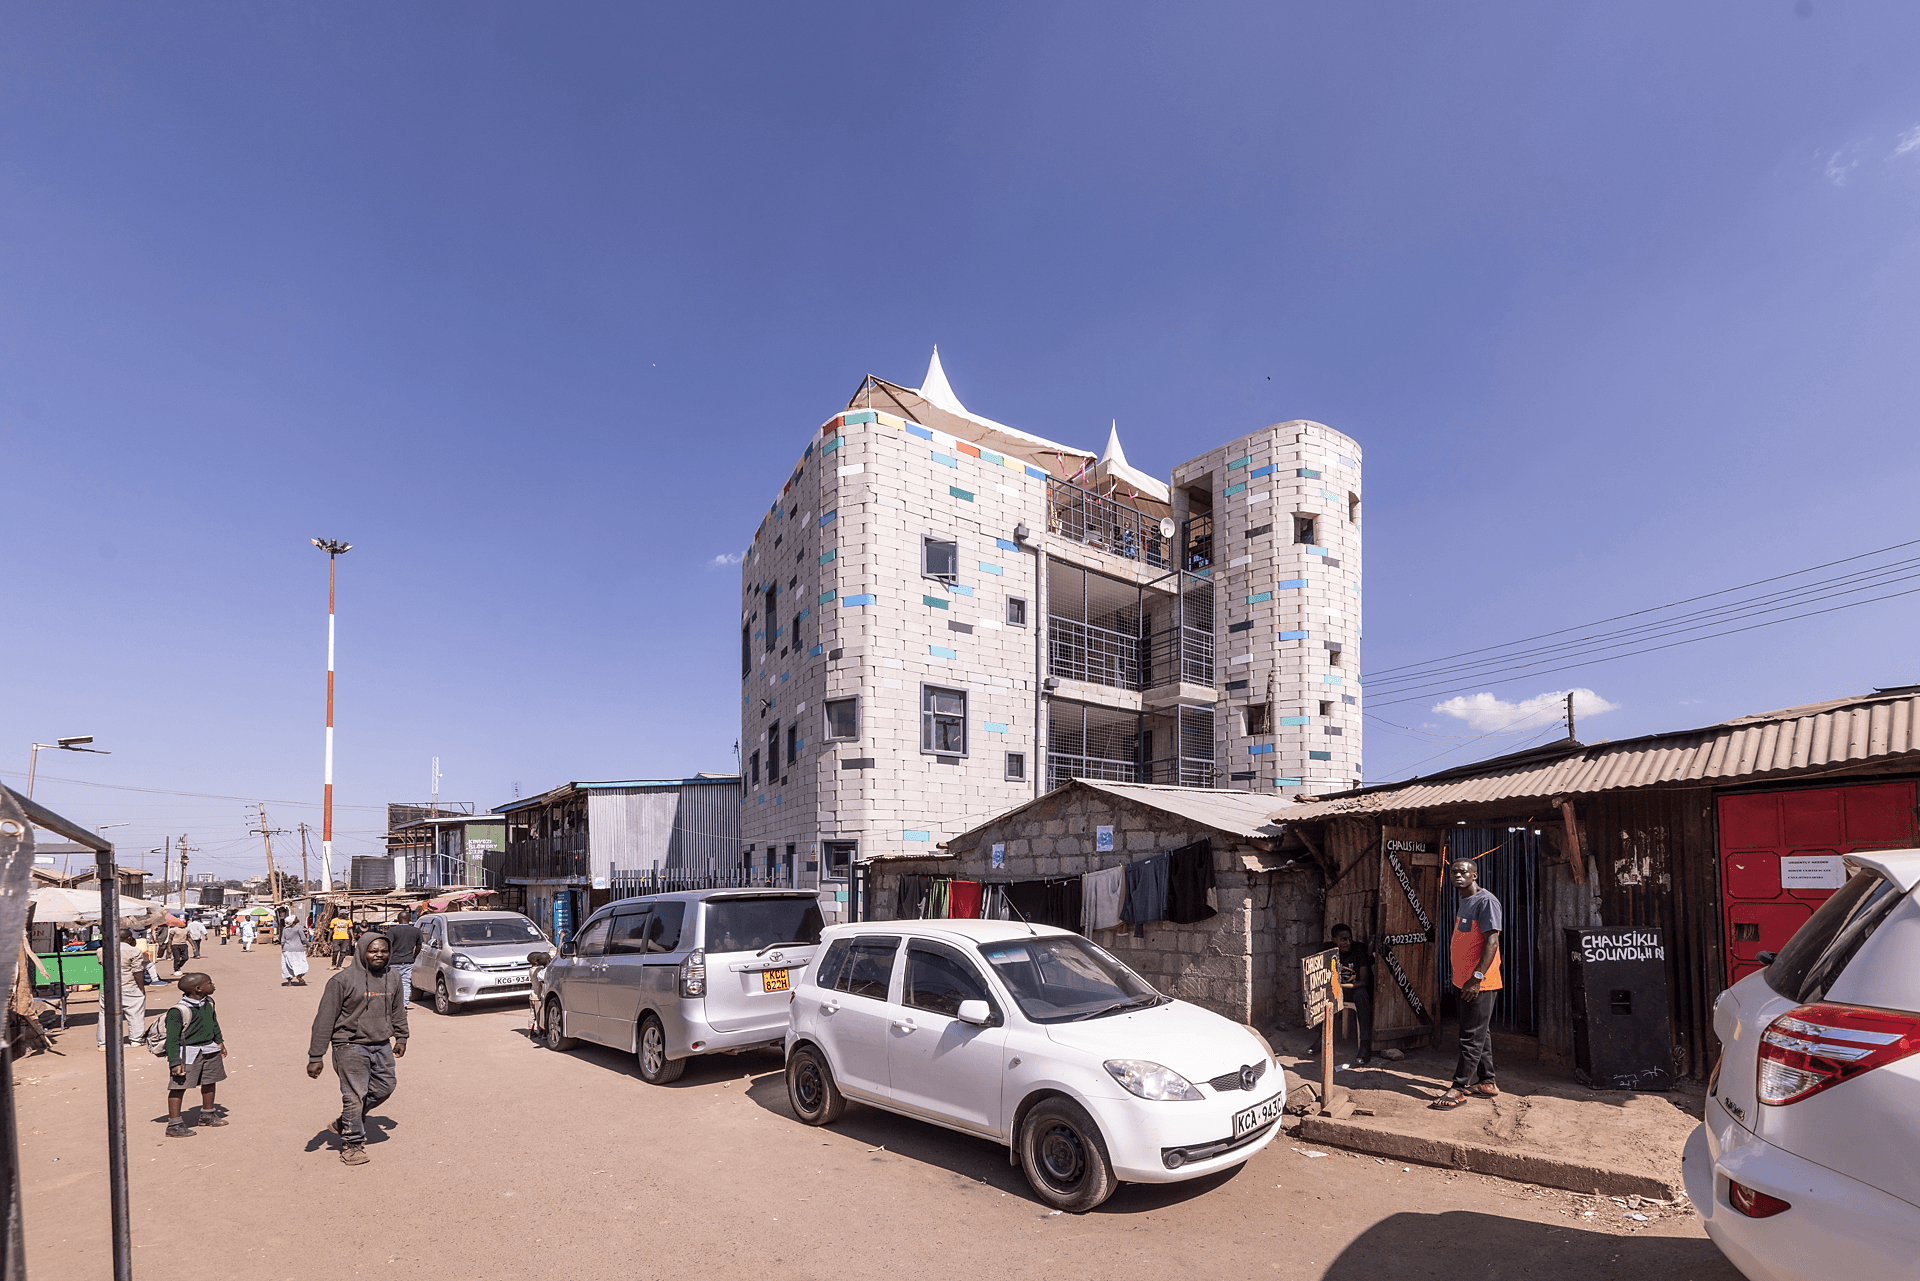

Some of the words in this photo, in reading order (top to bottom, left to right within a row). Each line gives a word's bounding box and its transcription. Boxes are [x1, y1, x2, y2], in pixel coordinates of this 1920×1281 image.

[769, 969, 787, 980] KCC
[766, 980, 787, 990] 822H
[1385, 951, 1407, 987] SOUND
[1407, 988, 1423, 1015] HIRE
